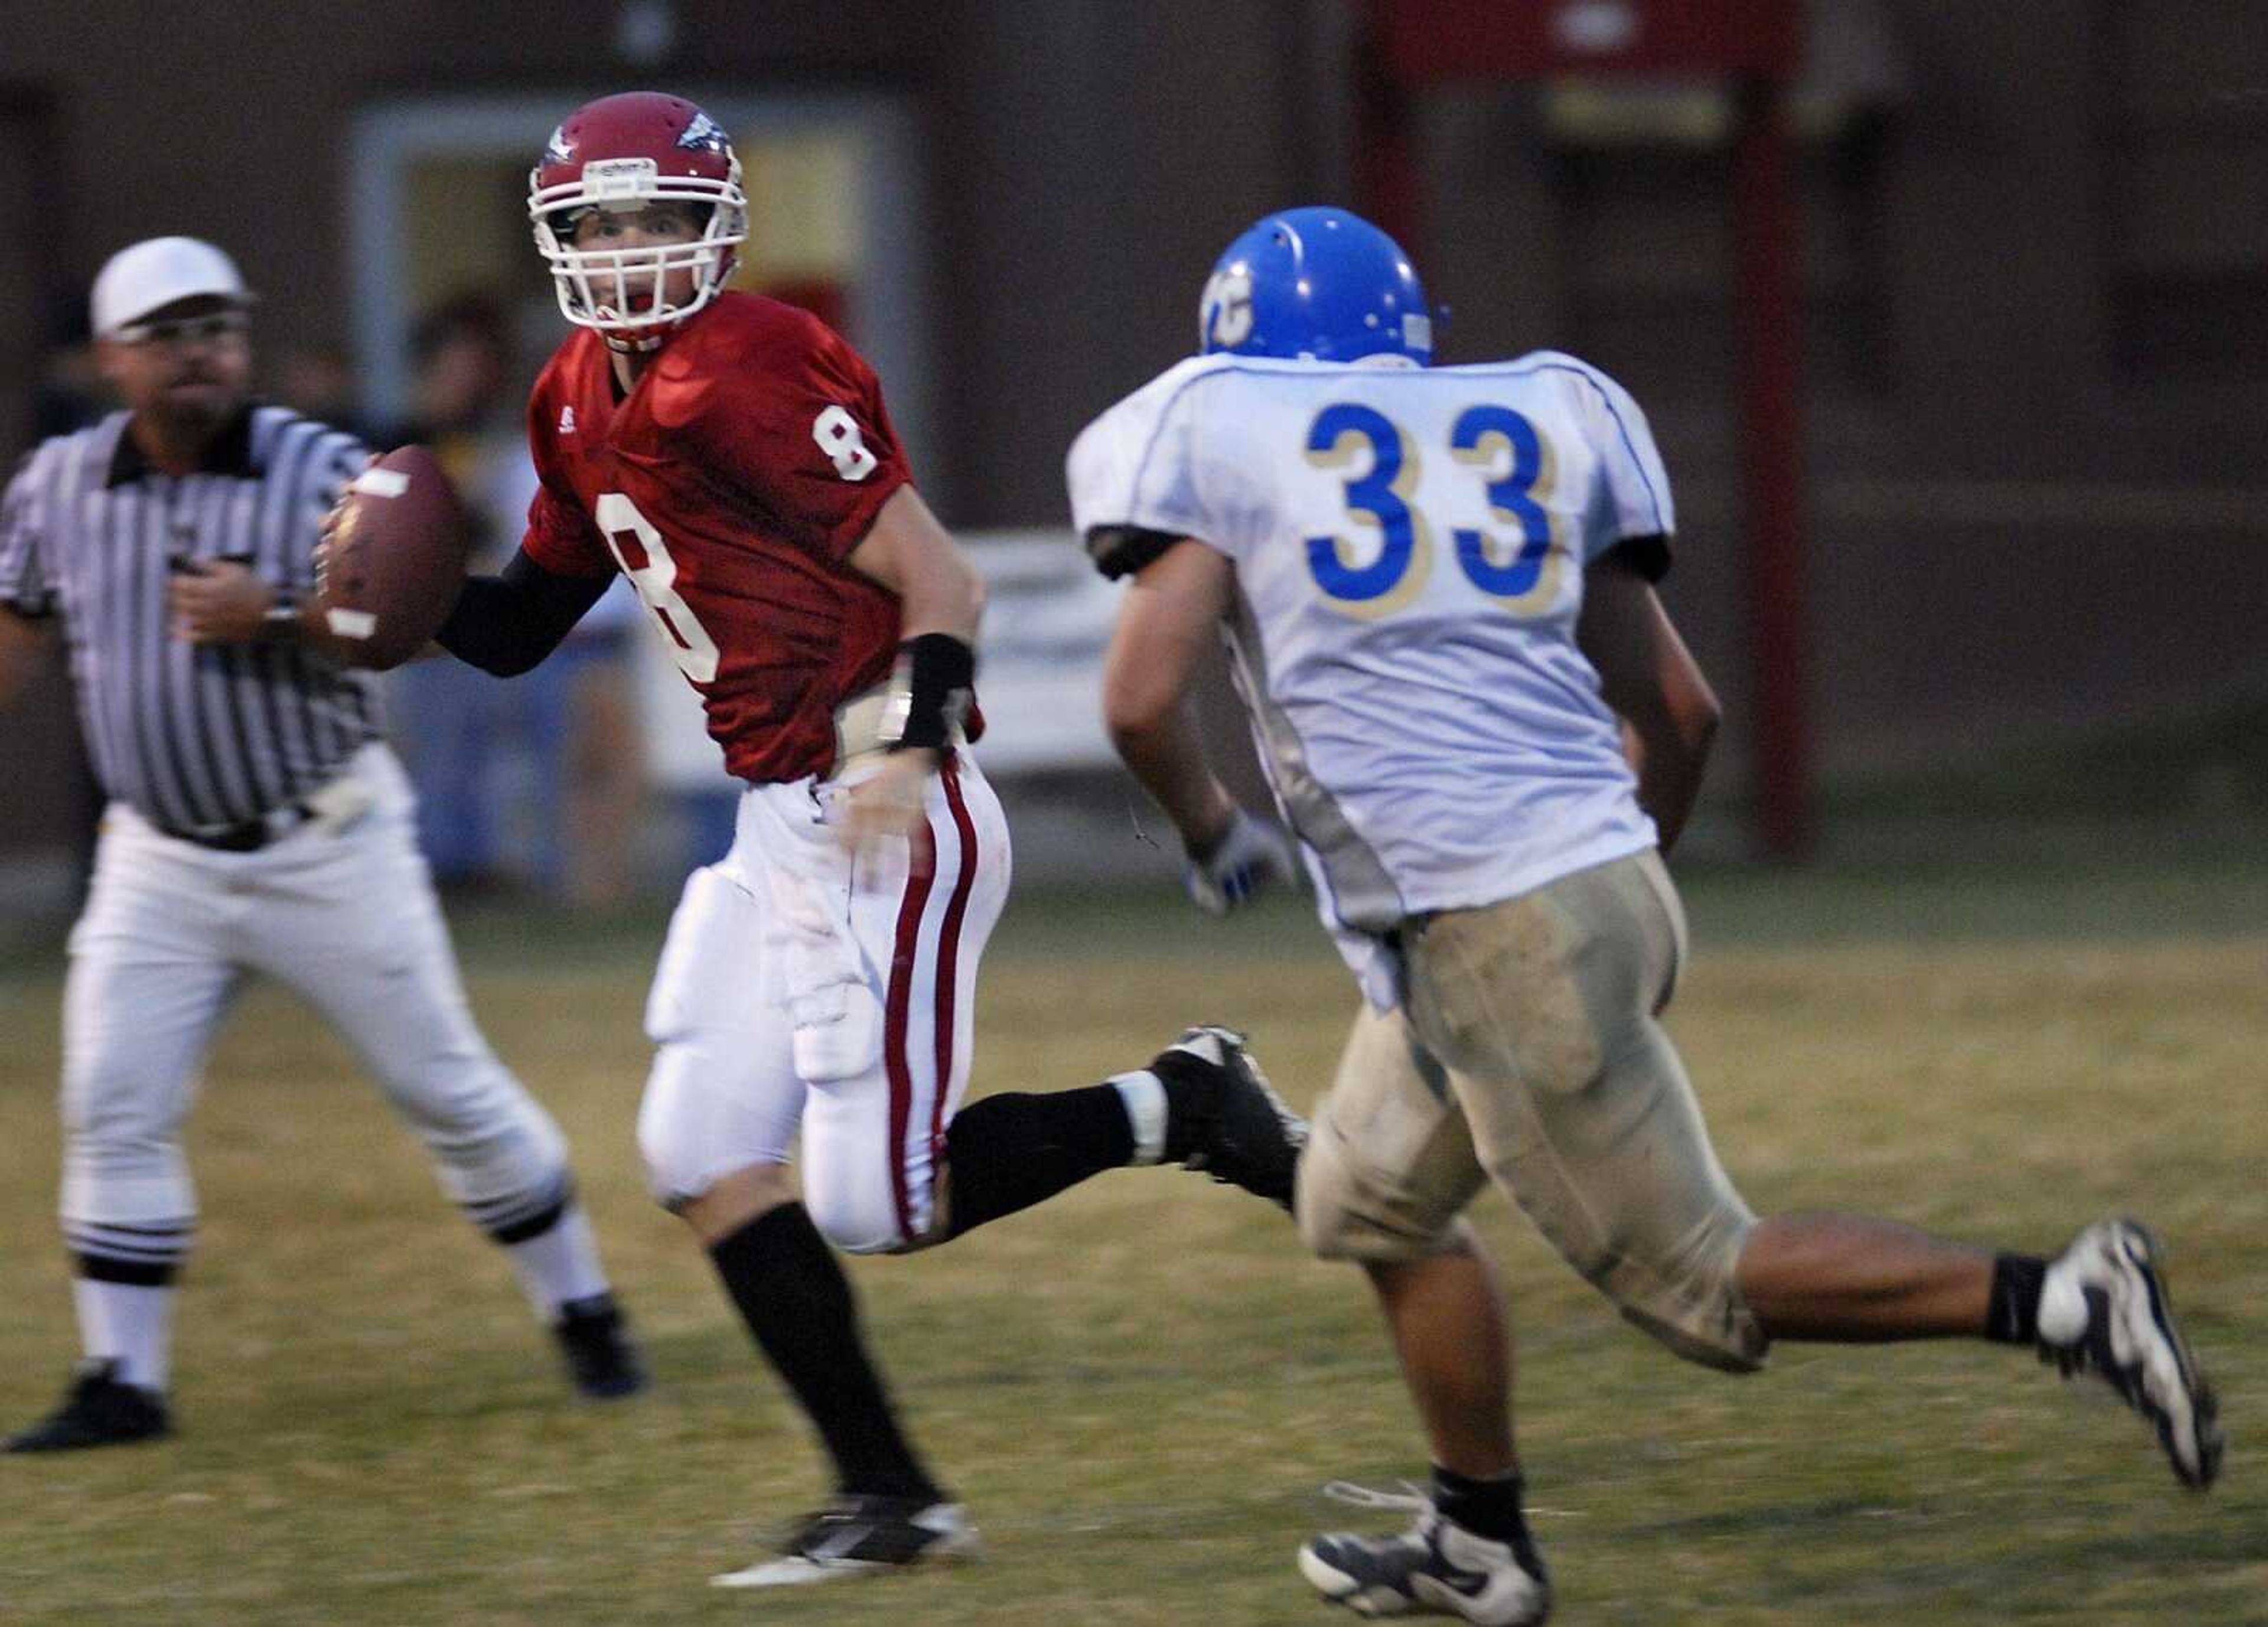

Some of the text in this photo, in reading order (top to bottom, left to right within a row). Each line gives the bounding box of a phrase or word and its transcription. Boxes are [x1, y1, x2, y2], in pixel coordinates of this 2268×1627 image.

[812, 405, 878, 481] 8
[1304, 402, 1563, 619] 33
[595, 493, 721, 684] 8
